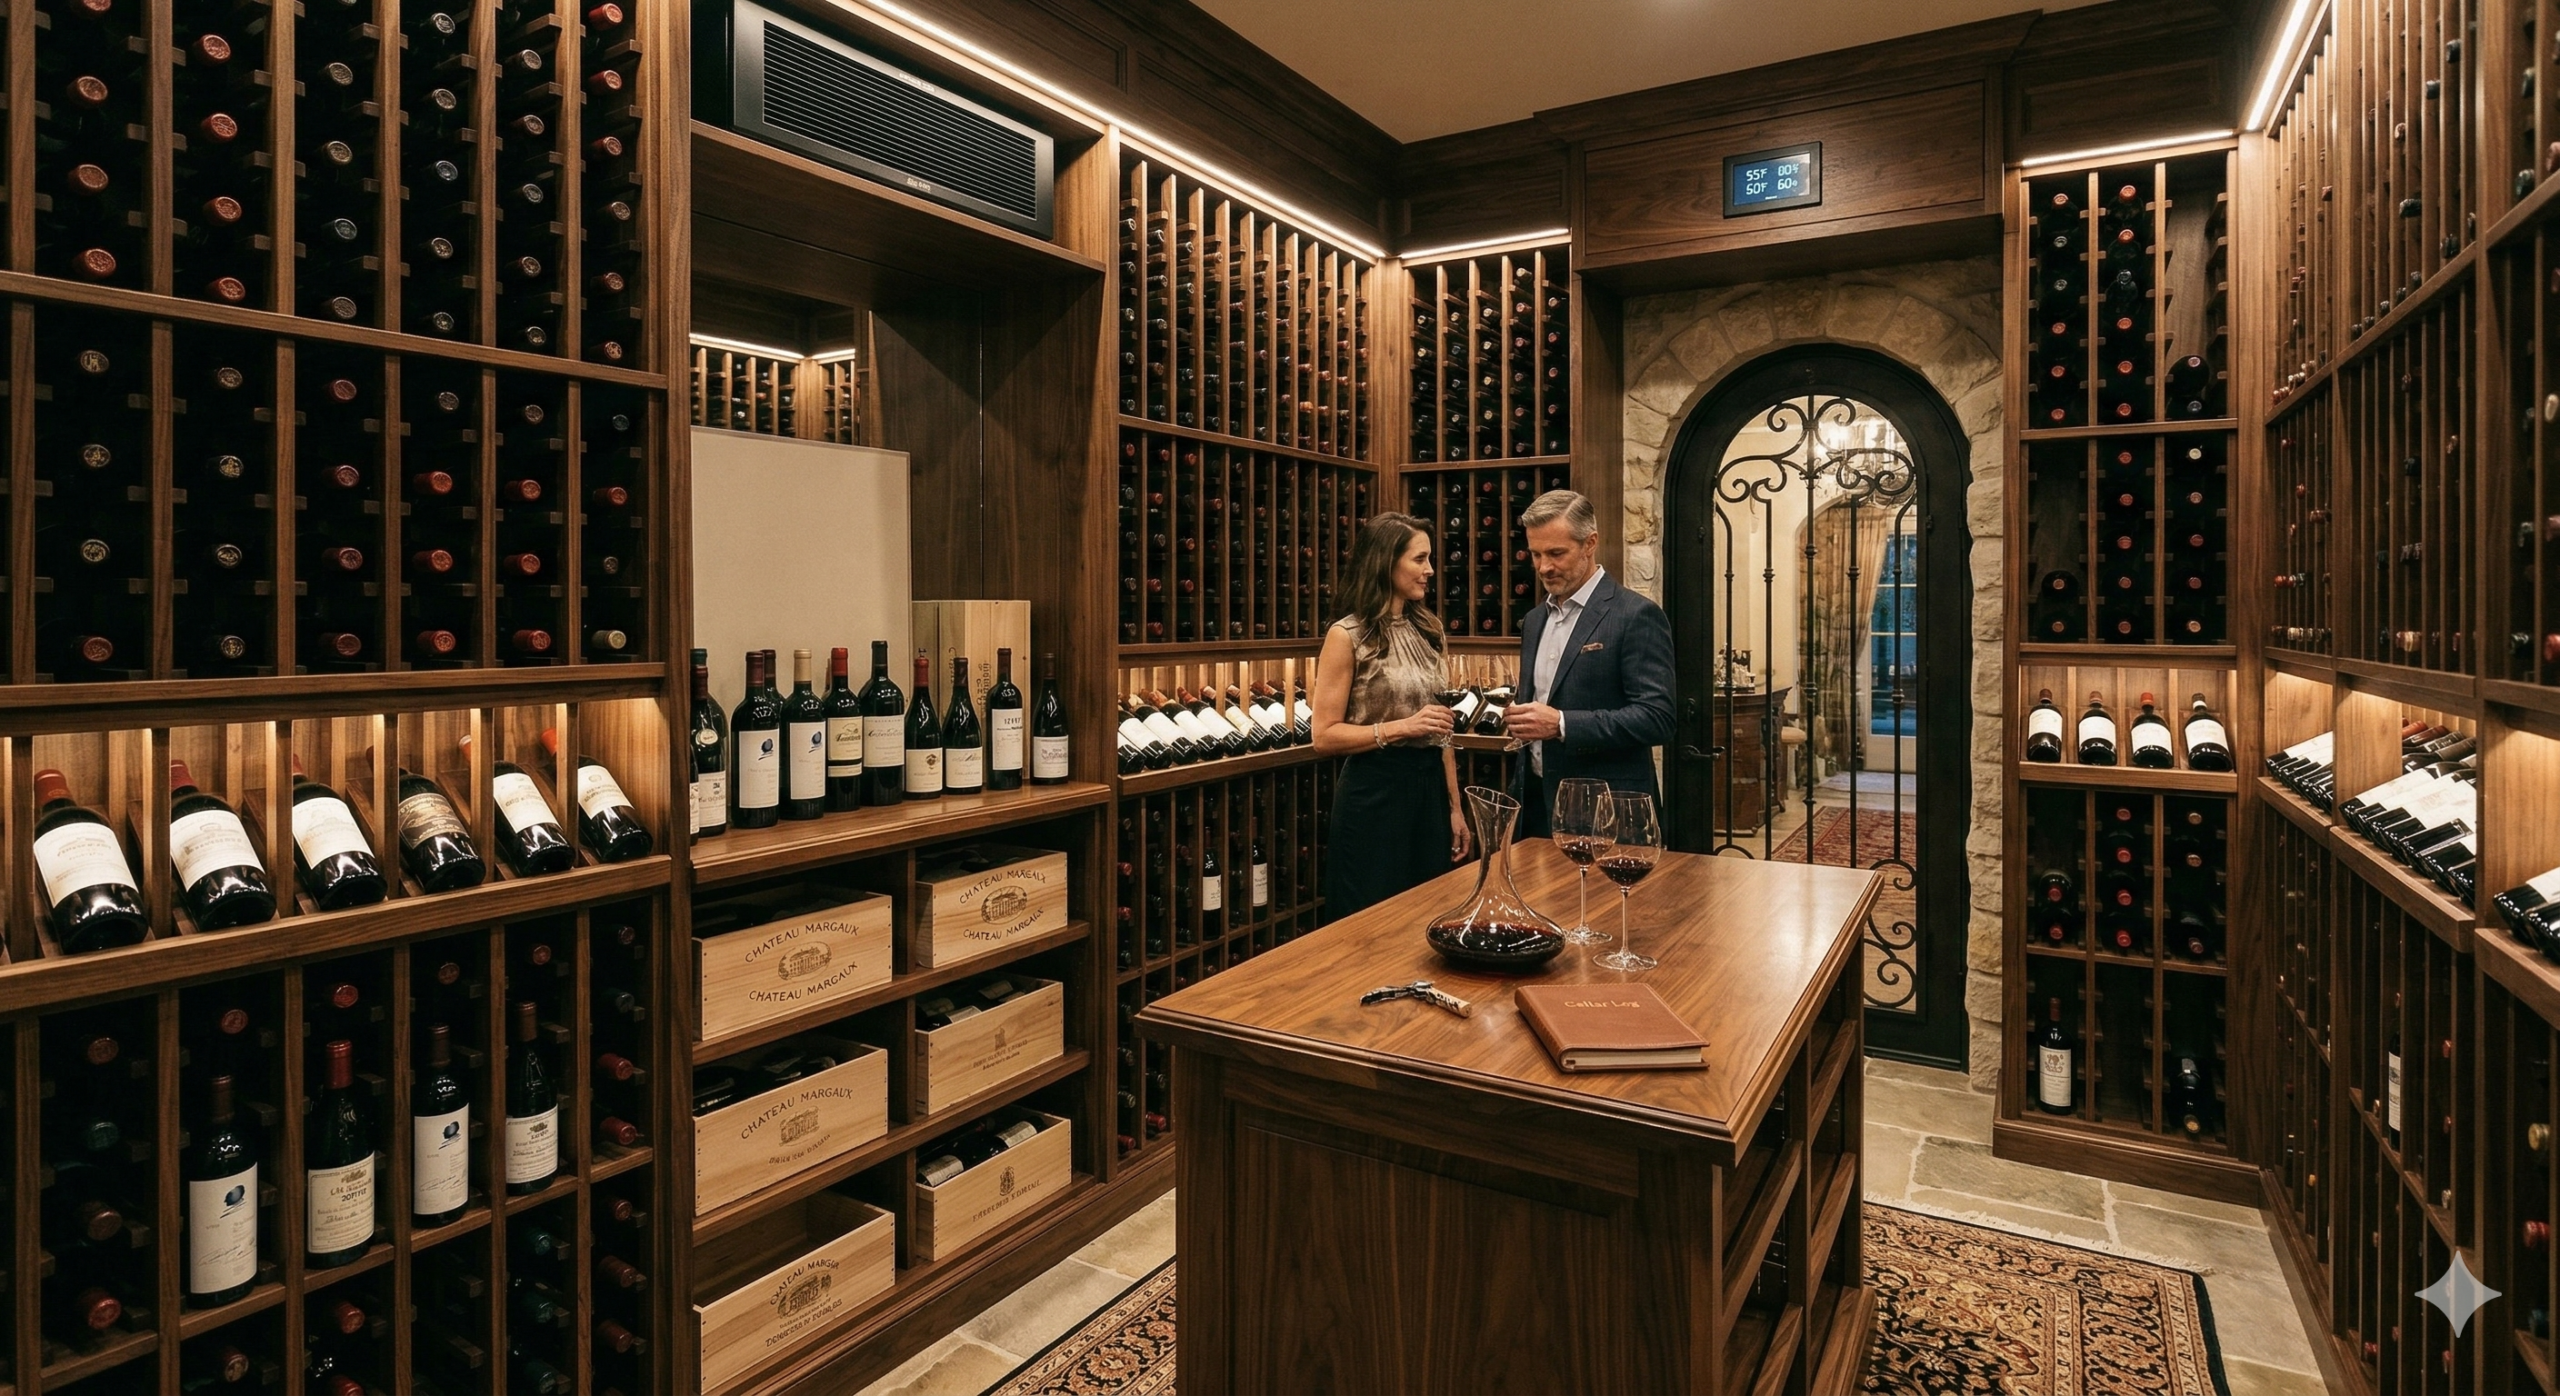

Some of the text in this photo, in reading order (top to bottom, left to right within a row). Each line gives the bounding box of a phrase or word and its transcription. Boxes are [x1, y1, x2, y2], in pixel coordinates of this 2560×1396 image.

[959, 873, 1003, 904] CHATEAU
[744, 921, 860, 963] CHATEAU MARGAUX
[963, 928, 1002, 941] CHATEAU
[749, 961, 858, 1002] CHATEAU MARGAUX
[741, 1087, 853, 1140] CHATEAU MARGAUX
